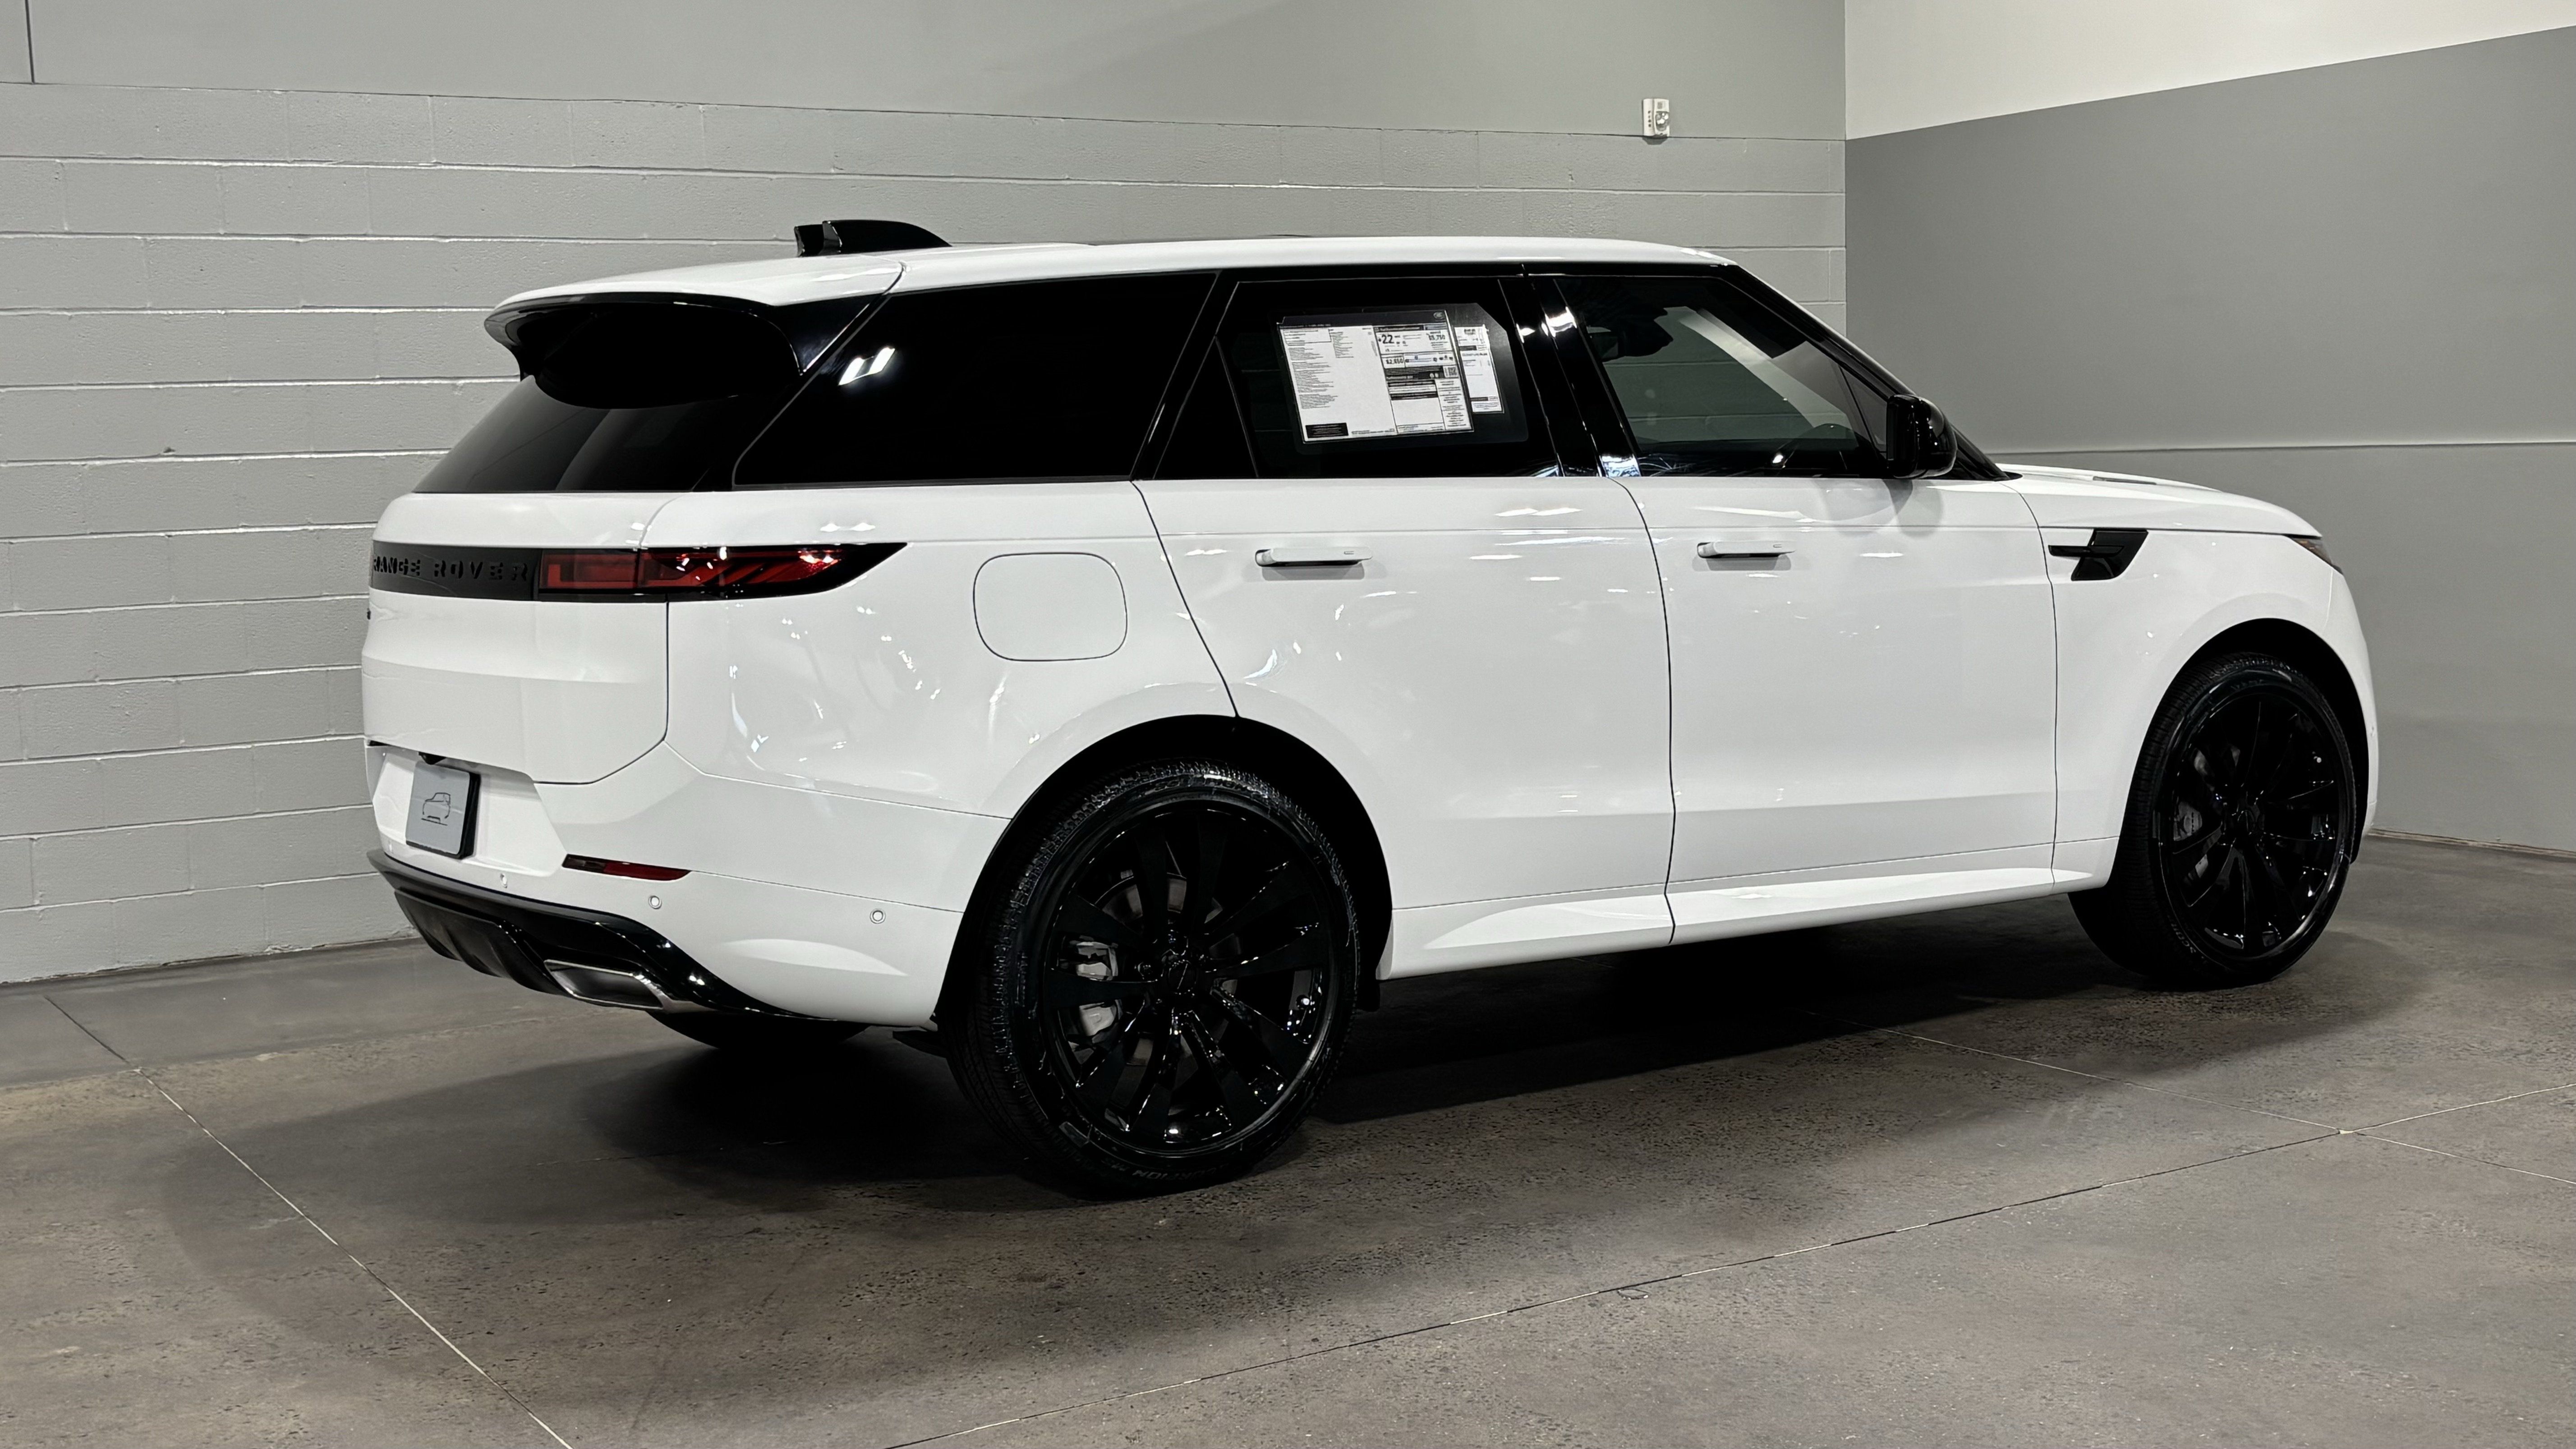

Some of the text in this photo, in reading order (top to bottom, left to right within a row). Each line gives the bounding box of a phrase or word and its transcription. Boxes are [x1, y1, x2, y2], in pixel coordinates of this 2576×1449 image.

[1382, 334, 1394, 344] 22
[374, 556, 528, 581] RANGE ROVER
